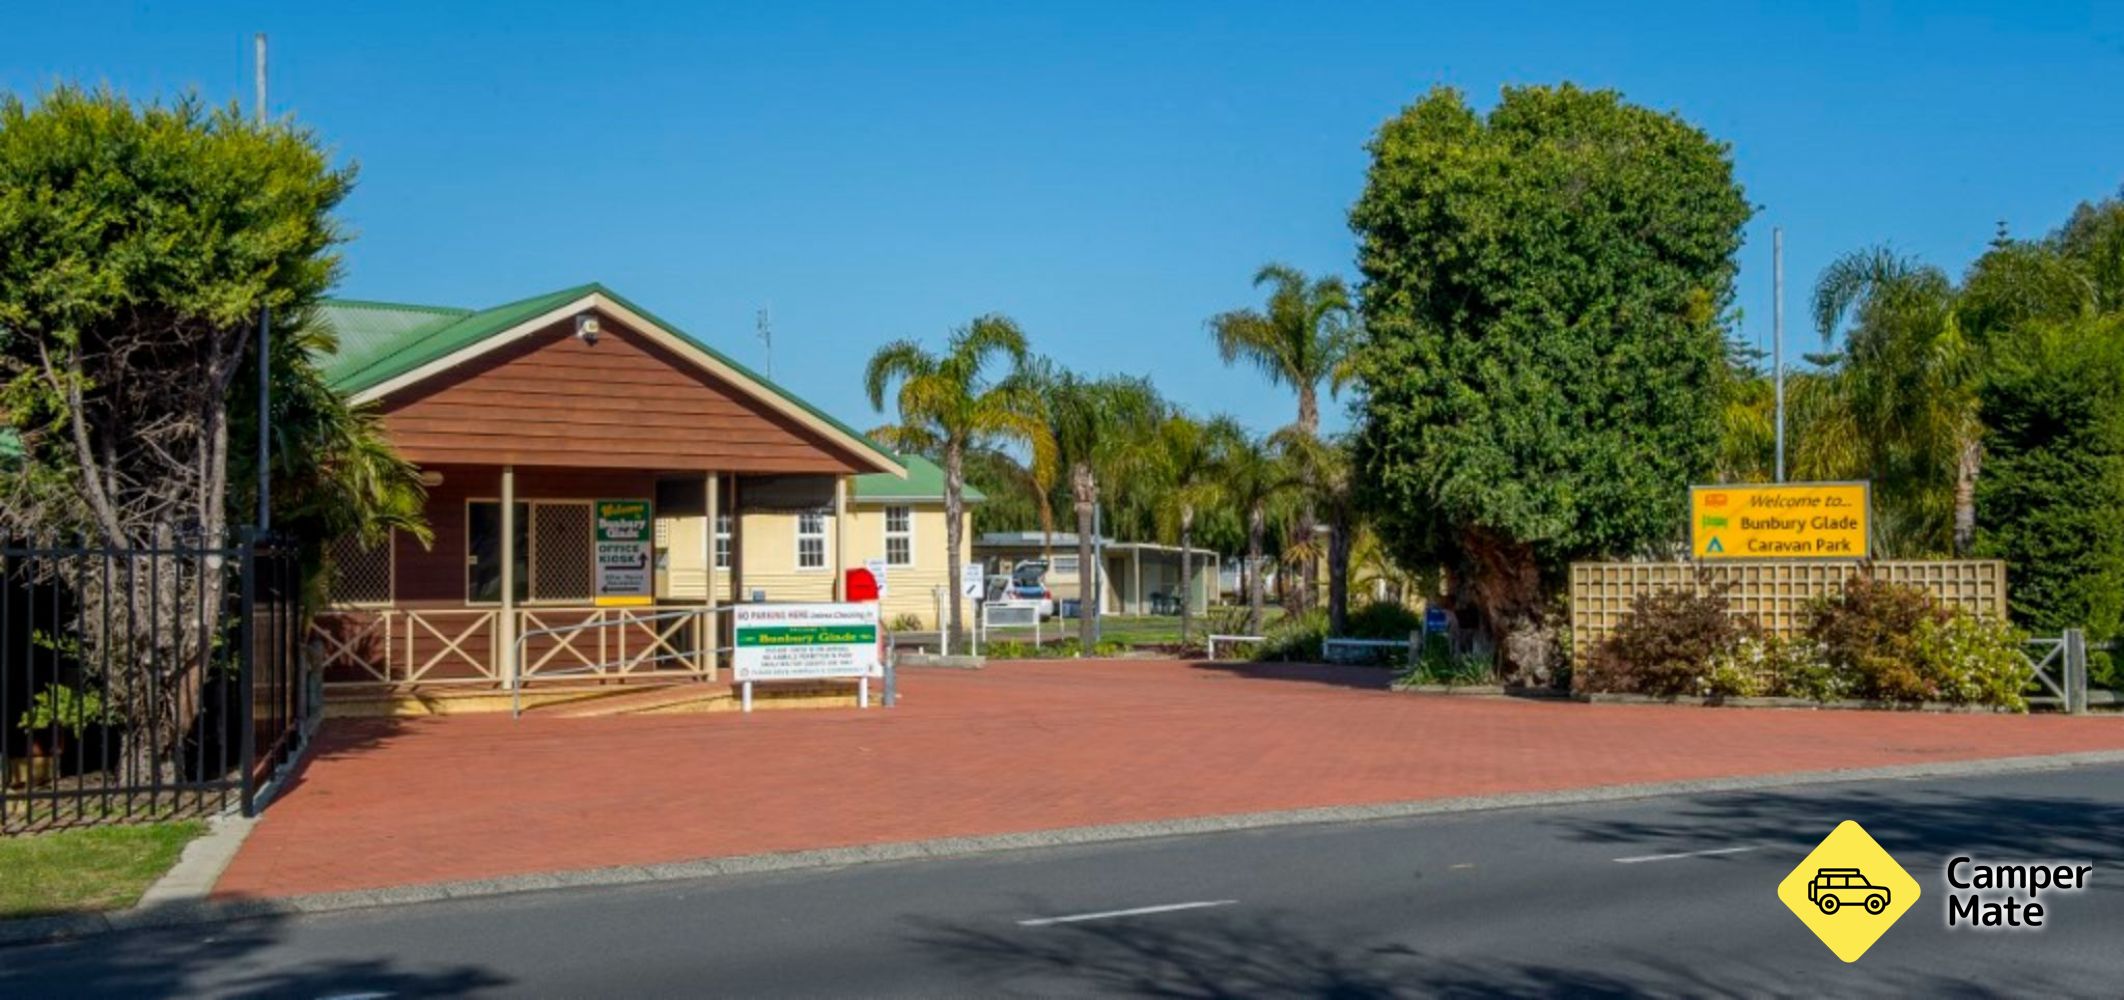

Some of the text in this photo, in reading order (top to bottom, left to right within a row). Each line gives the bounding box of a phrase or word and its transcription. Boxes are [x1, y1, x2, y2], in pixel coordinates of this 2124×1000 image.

[1751, 495, 1820, 508] Welcome
[1741, 516, 1858, 534] Bunbury Glade
[599, 545, 639, 553] OFFICE
[1748, 538, 1851, 552] Caravan Park
[599, 555, 635, 563] KIOSK
[751, 611, 786, 620] PARKING
[788, 610, 808, 619] HERE
[758, 632, 856, 645] Bunbury Glade
